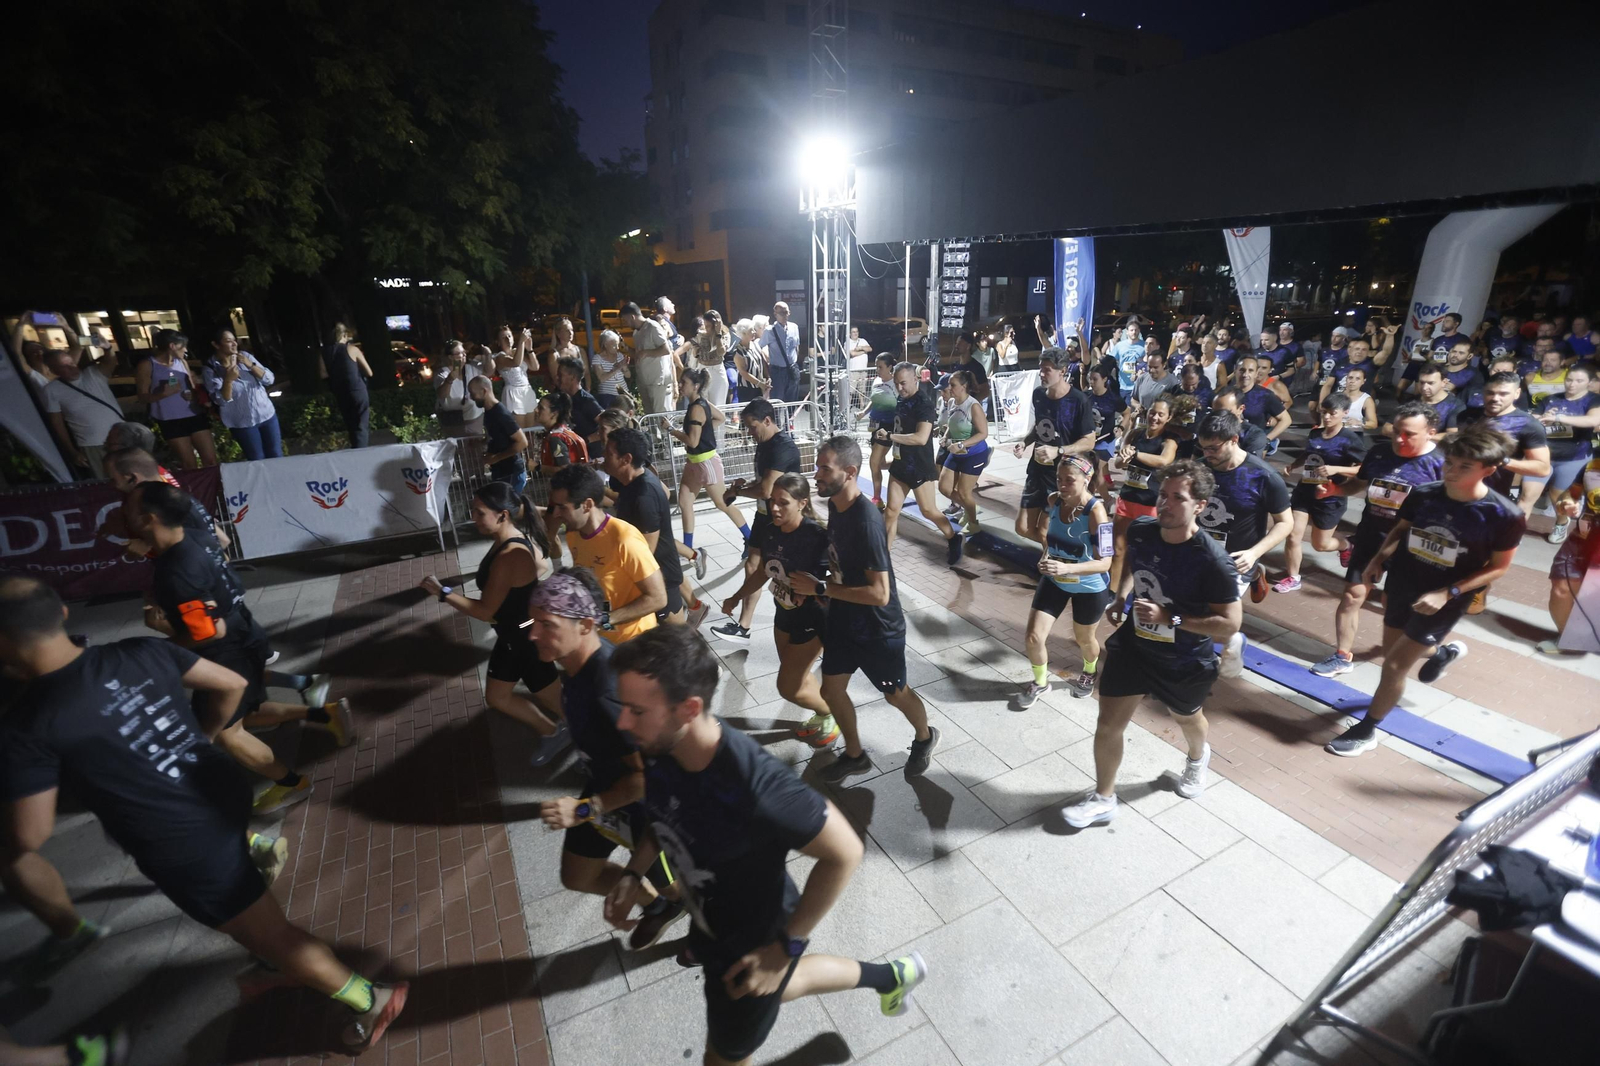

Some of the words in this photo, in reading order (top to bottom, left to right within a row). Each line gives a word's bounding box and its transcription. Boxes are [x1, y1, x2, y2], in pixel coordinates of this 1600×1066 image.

[1414, 302, 1450, 319] Rock
[1002, 396, 1020, 408] Rock
[306, 477, 348, 497] Rock
[1384, 489, 1391, 498] 8
[1420, 539, 1444, 555] 1104
